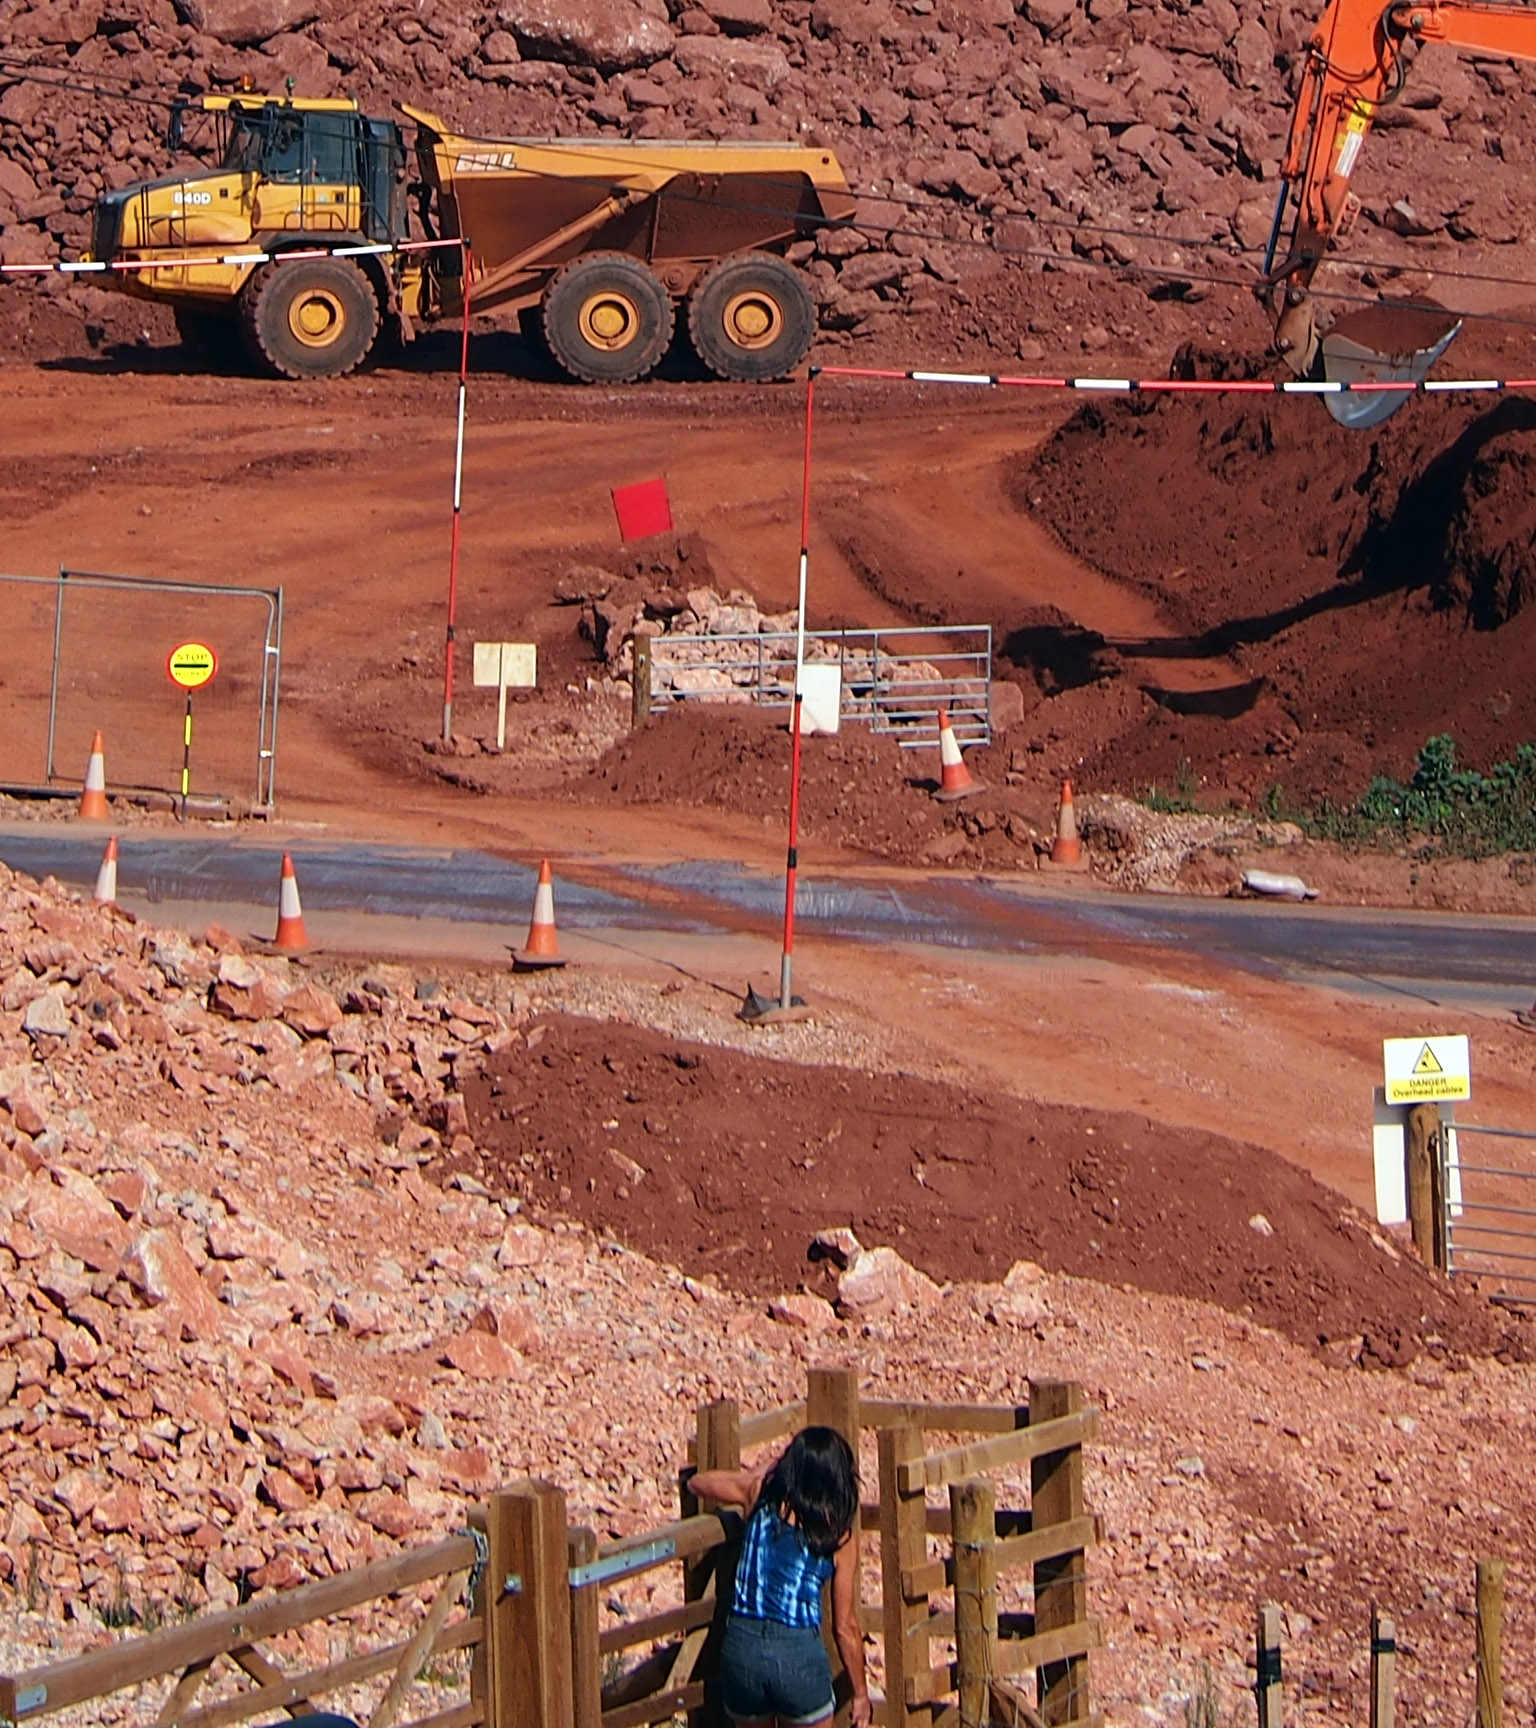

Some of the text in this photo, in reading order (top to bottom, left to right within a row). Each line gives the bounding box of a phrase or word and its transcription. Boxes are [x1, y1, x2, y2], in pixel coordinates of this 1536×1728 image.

[456, 153, 515, 172] BELL
[174, 191, 212, 205] B40D
[1409, 1077, 1447, 1088] DANGER
[1393, 1085, 1463, 1098] Overhead cables
